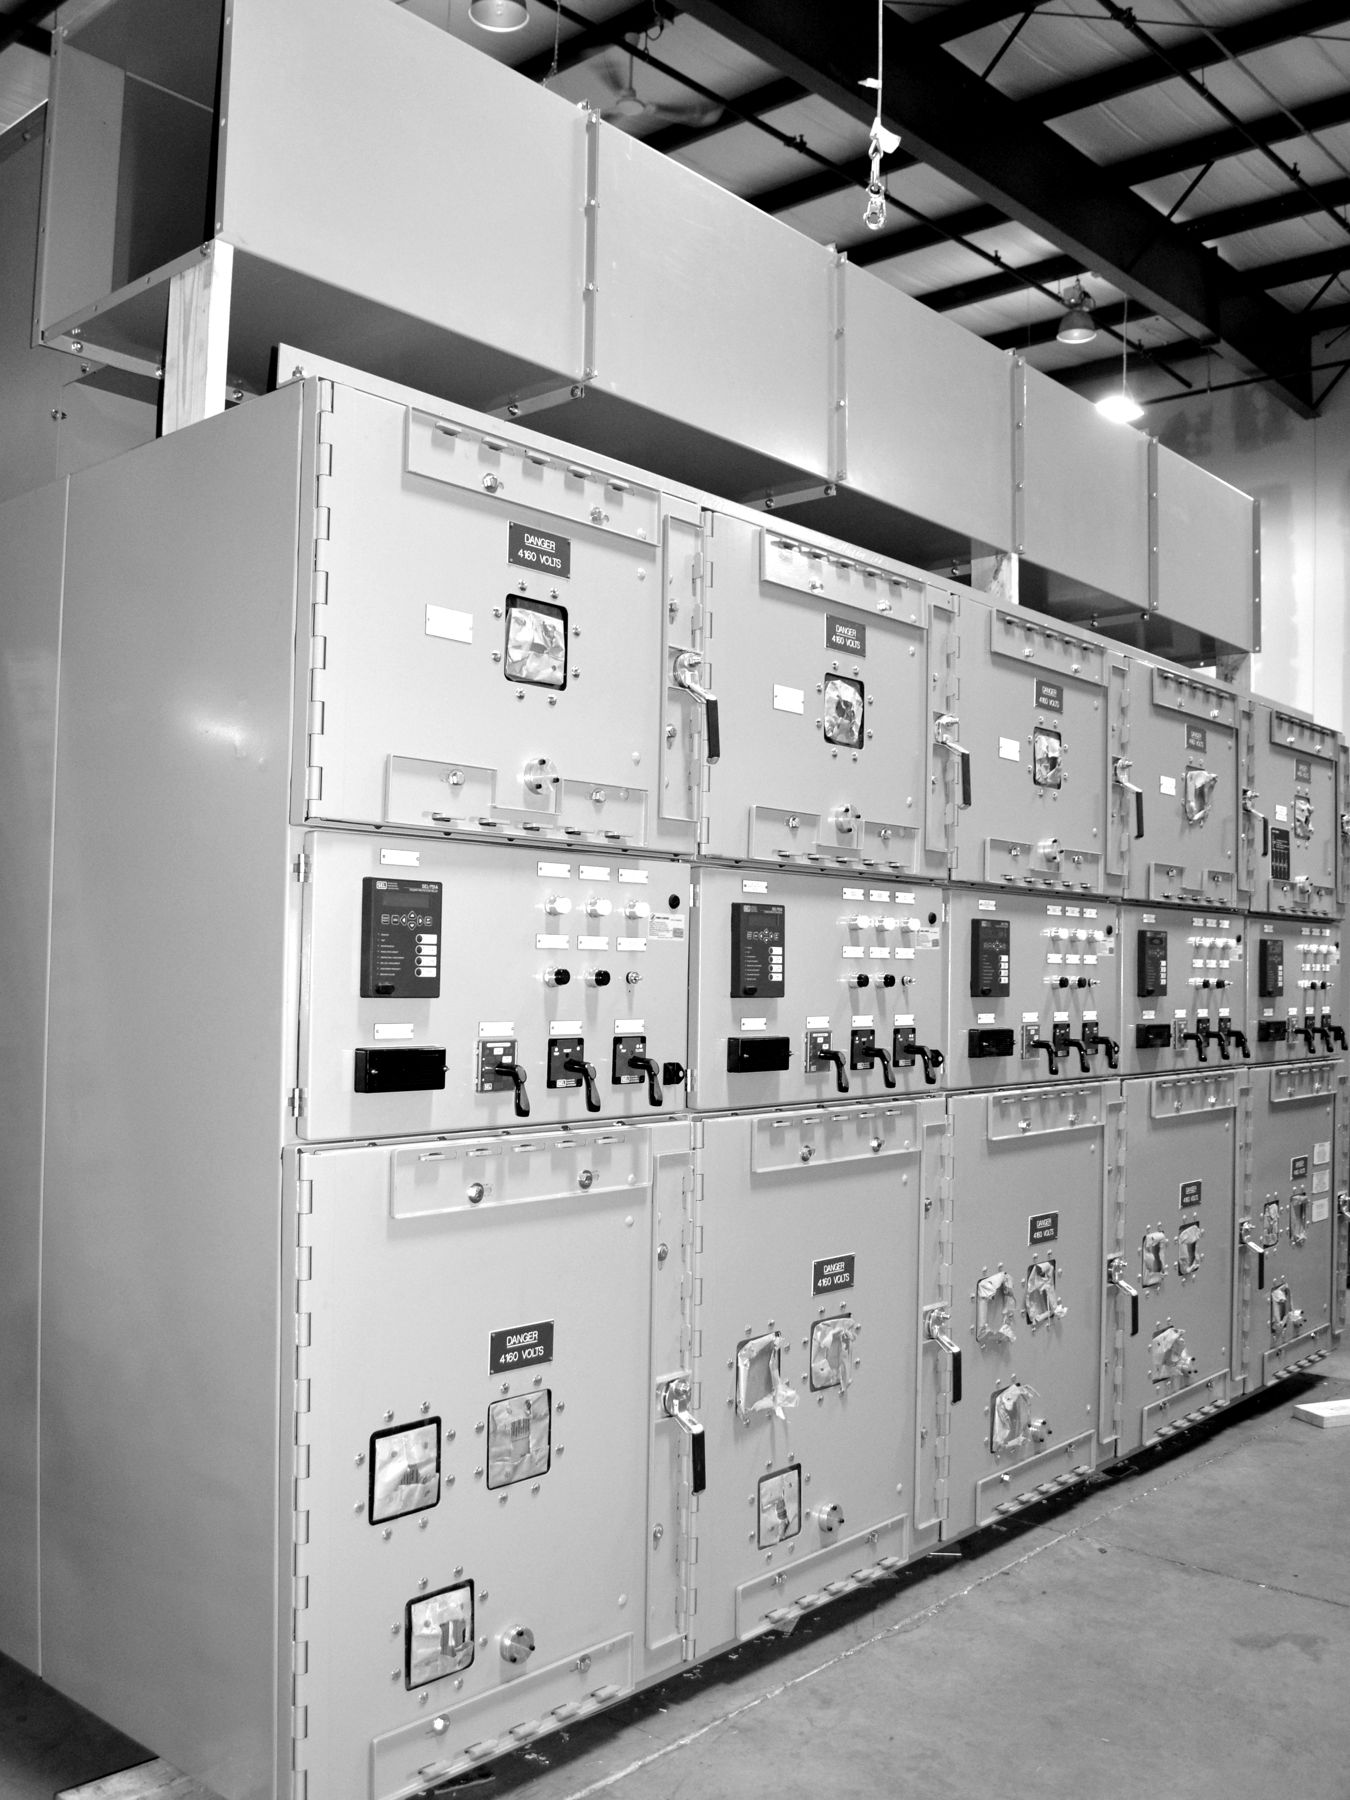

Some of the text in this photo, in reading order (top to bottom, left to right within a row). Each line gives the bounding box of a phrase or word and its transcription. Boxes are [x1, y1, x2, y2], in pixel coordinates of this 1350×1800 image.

[525, 534, 555, 550] DANGER
[518, 549, 562, 568] 4160 VOLTS
[836, 624, 856, 637] DANGER
[832, 634, 861, 649] 4160 VOLTS
[824, 1261, 845, 1273] DANGER
[817, 1273, 850, 1287] 4160 VOLTS
[506, 1331, 538, 1346] DANGER
[500, 1346, 544, 1364] 4160 VOLTS
